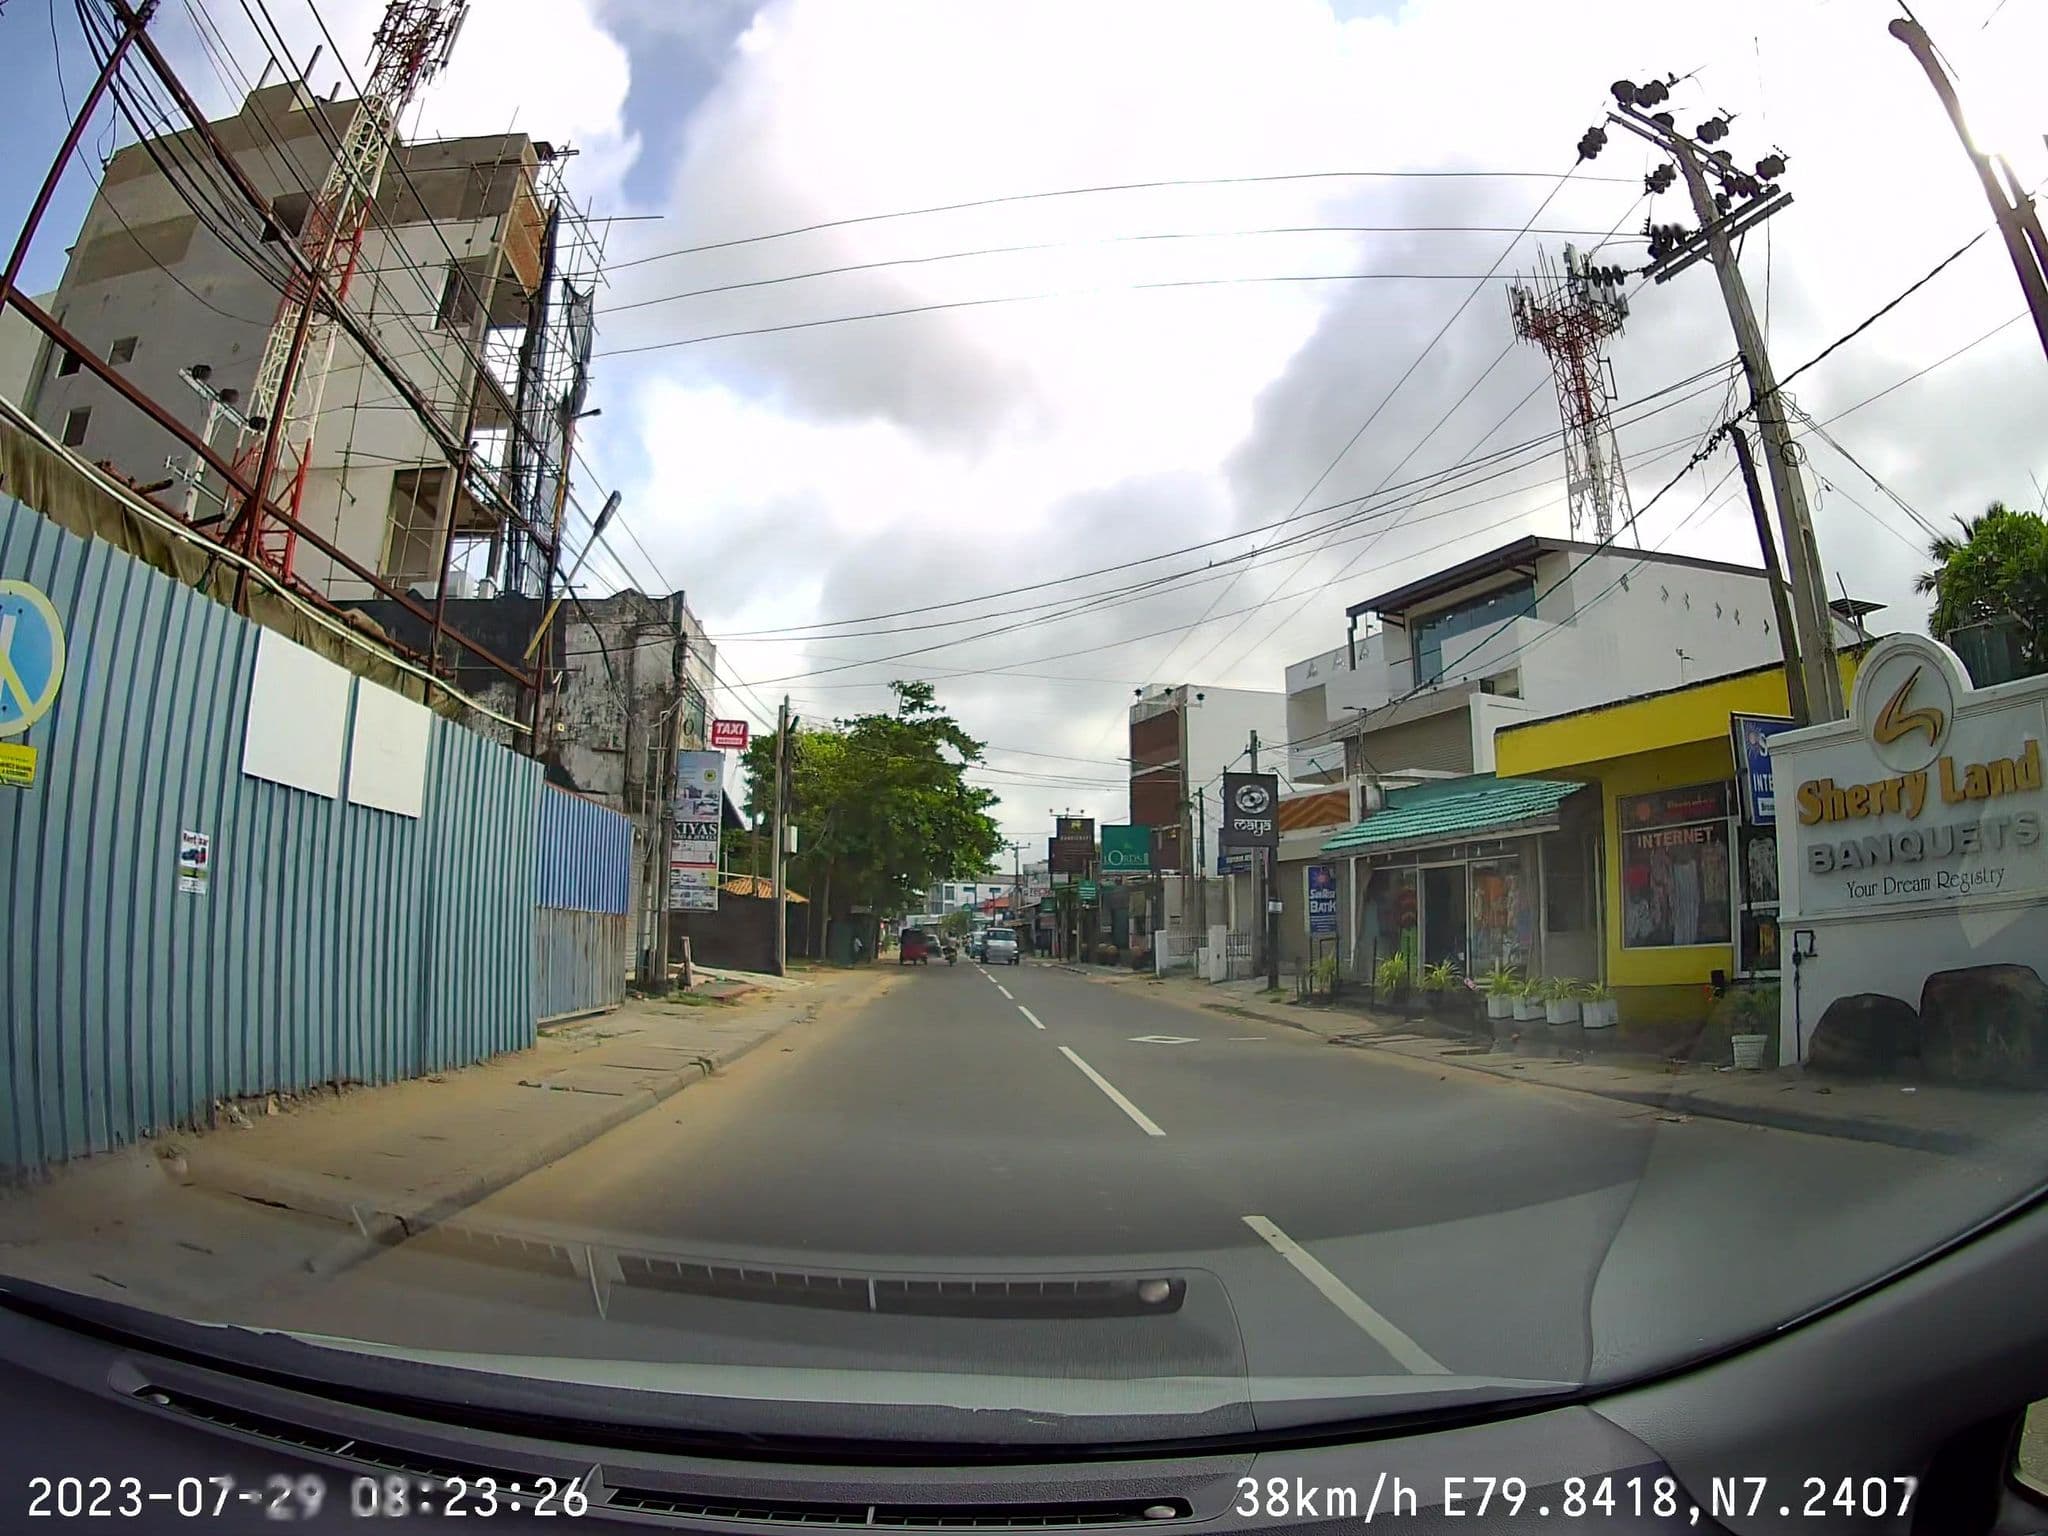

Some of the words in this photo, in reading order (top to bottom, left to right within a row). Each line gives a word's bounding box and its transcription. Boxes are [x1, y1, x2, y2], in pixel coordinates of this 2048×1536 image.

[715, 723, 745, 735] TAXI
[1796, 771, 1928, 825] Sherry
[1938, 739, 2043, 806] Land
[1637, 825, 1714, 849] INTERNET
[1807, 811, 2041, 874] BANQUETS
[1846, 878, 1878, 899] Your
[1883, 875, 1932, 896] Dream
[1936, 867, 2006, 894] Registry
